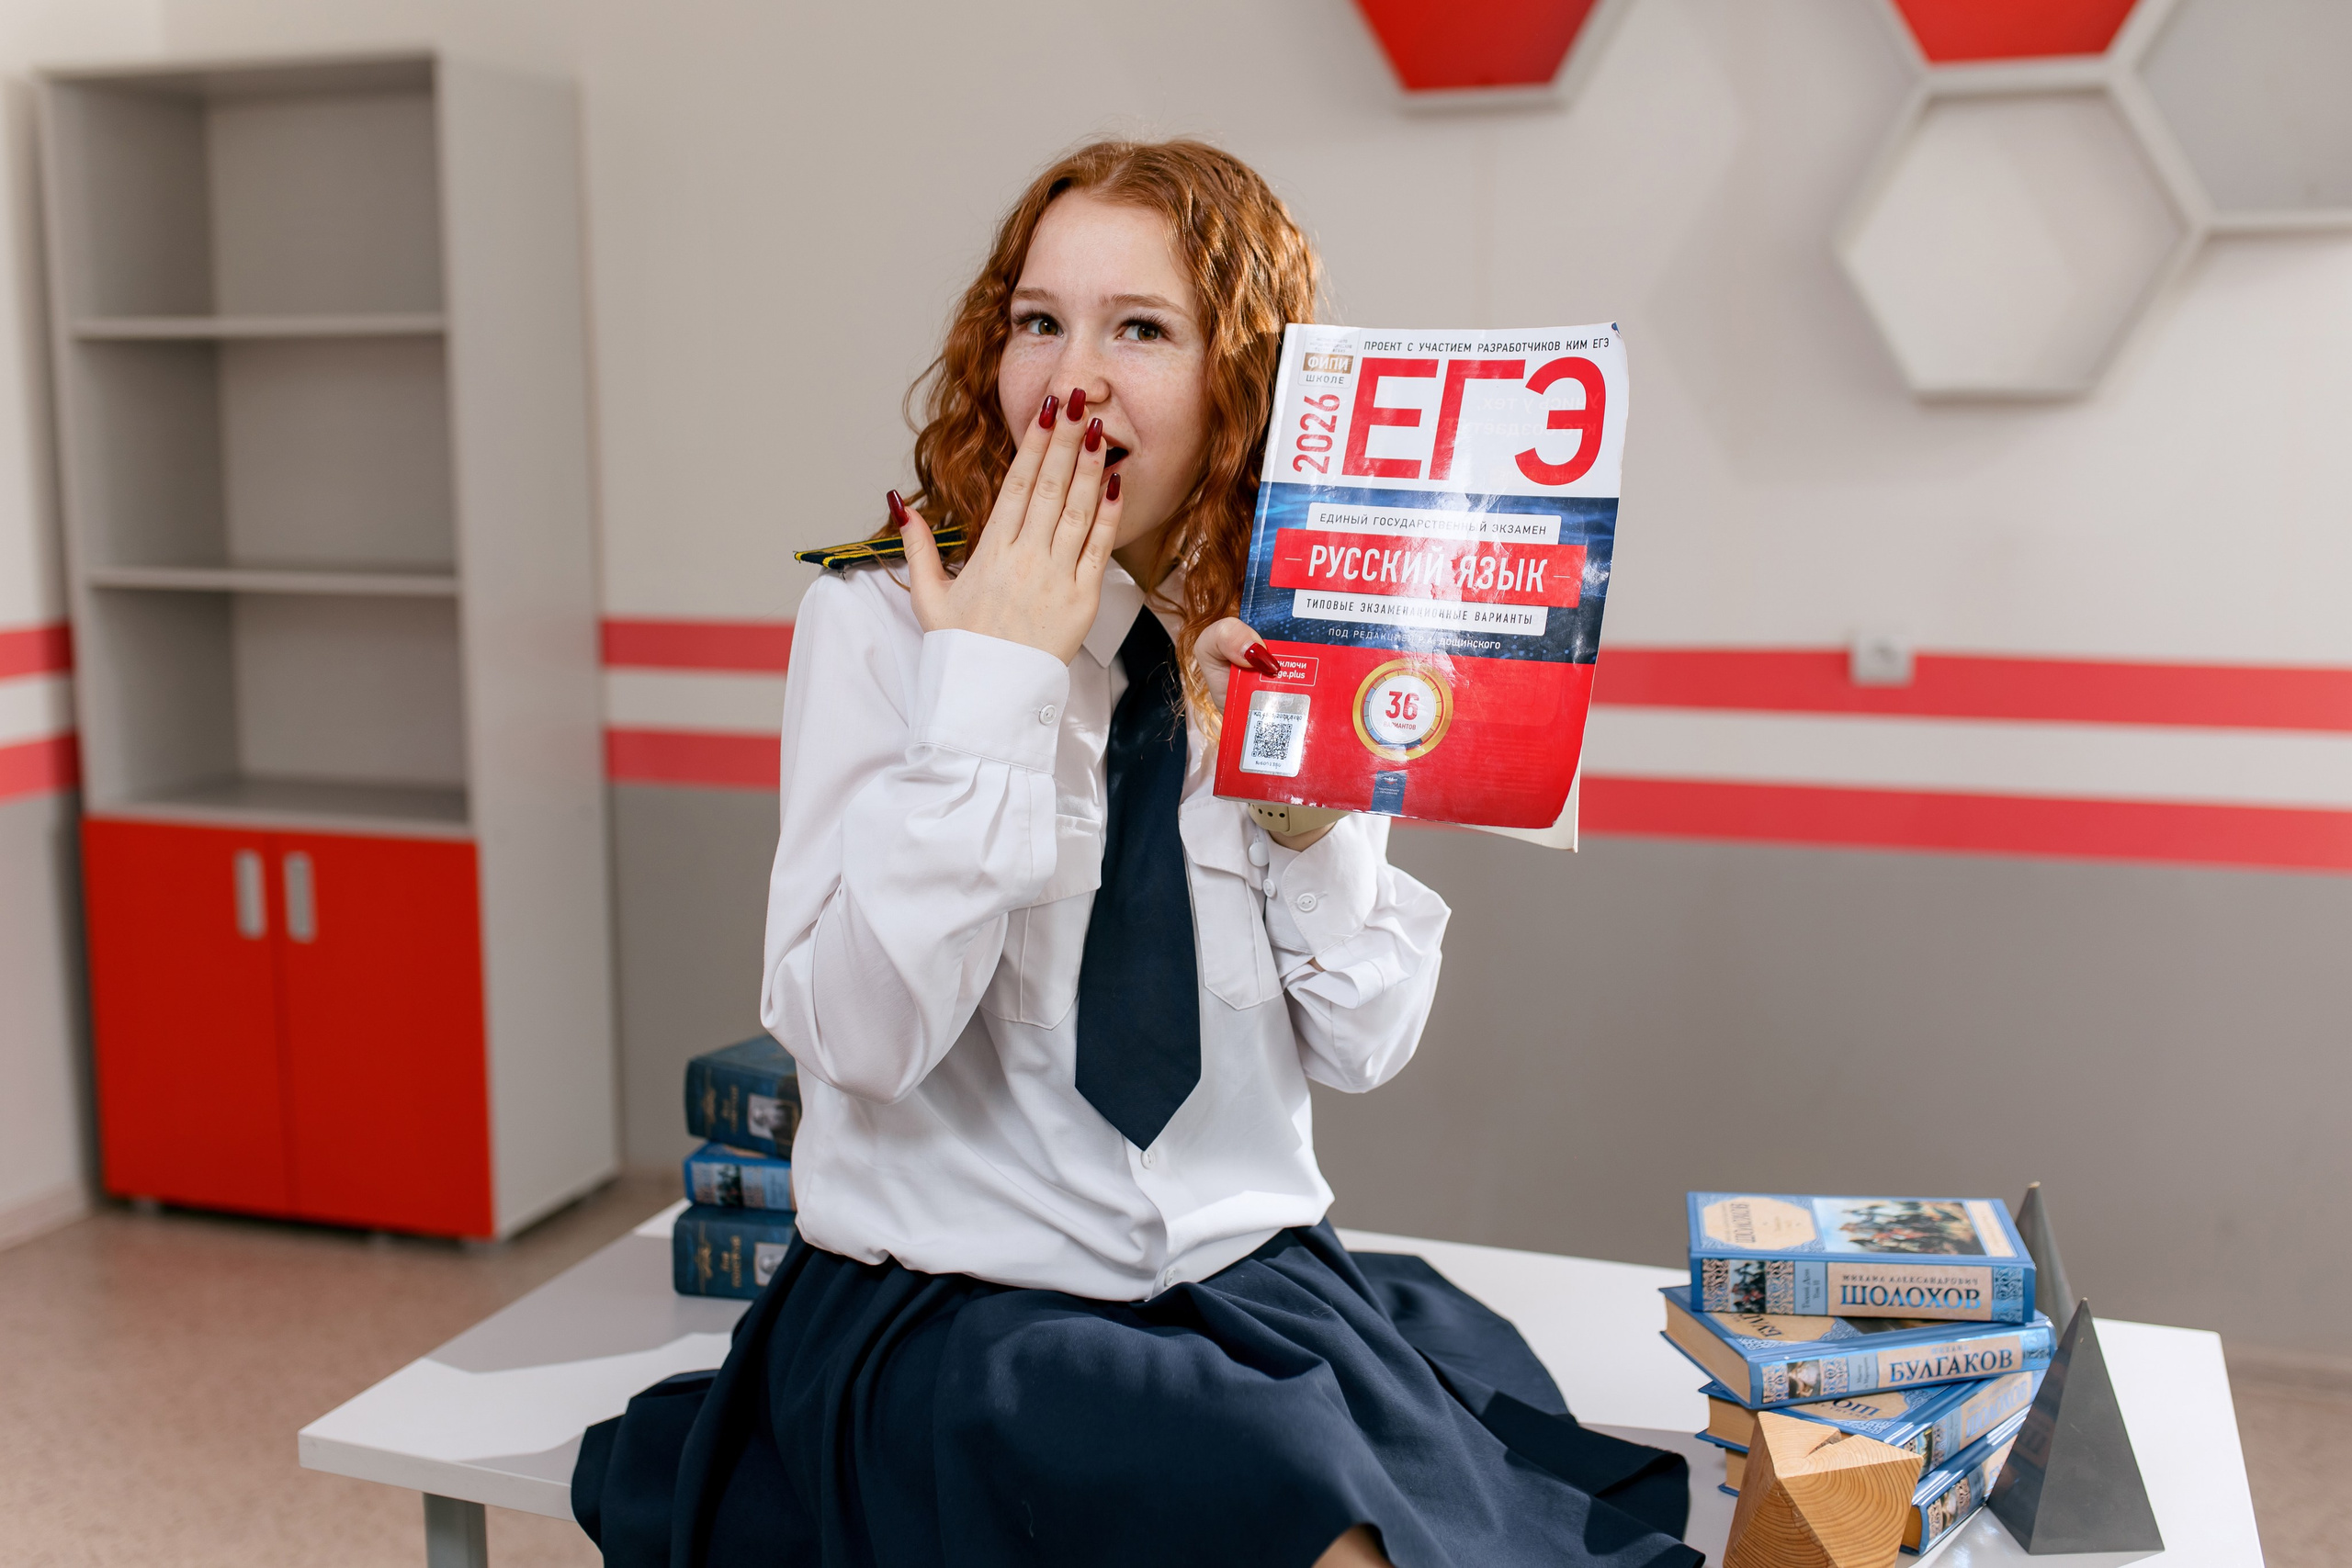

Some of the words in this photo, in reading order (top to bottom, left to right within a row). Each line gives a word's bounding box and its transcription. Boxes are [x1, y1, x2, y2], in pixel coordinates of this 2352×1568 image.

[1363, 341, 1402, 351] ПРОЕКТ
[1407, 343, 1414, 352] С
[1419, 343, 1472, 353] УЧАСТИЕМ
[1477, 341, 1561, 353] РАЗРАБОТЧИКОВ
[1566, 339, 1588, 350] КИМ
[1592, 337, 1610, 349] ЕГЭ
[1307, 356, 1349, 371] ФИПИ
[1306, 375, 1345, 385] ШКОЛЕ
[1341, 355, 1606, 486] ЕГЭ
[1292, 393, 1340, 474] 2026
[1319, 513, 1368, 525] ЕДИНЫЙ
[1373, 516, 1487, 533] ГОСУДАРСТВЕННЫЙ
[1492, 524, 1547, 535] ЭКЗАМЕН
[1307, 544, 1445, 585] РУССКИЙ
[1456, 555, 1548, 592] ЯЗЫК
[1306, 598, 1354, 612] ТИПОВЫЕ
[1360, 602, 1468, 621] ЭКЗАМЕНАЦИОННЫЕ
[1474, 611, 1532, 625] ВАРИАНТЫ
[1328, 627, 1349, 638] ПОД
[1352, 630, 1415, 642] РЕДАКЦИЕЙ
[1276, 660, 1306, 670] ключи
[1276, 671, 1306, 680] ge.plus
[1385, 691, 1419, 721] 36
[1840, 1284, 1982, 1310] ШОЛОХОВ
[1889, 1348, 2013, 1383] БУЛГАКОВ
